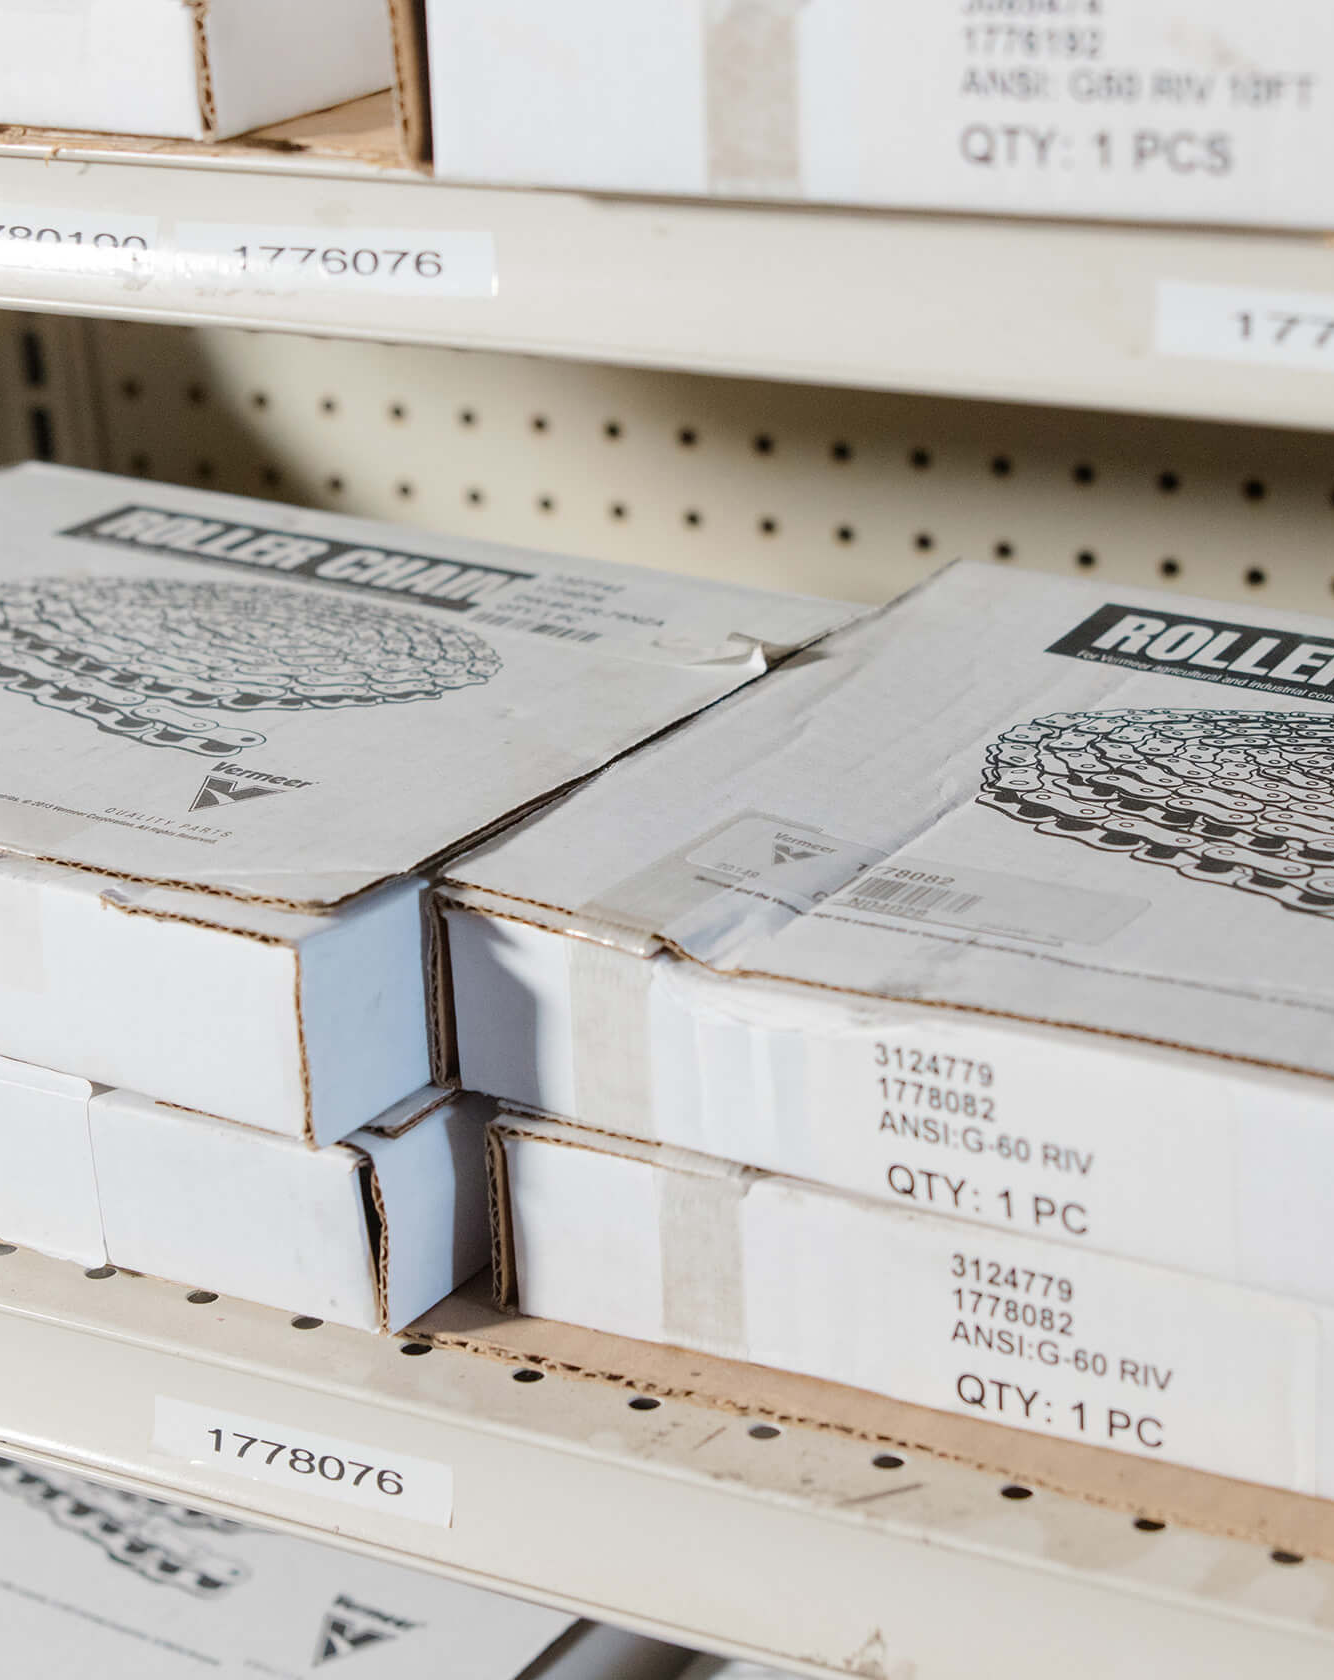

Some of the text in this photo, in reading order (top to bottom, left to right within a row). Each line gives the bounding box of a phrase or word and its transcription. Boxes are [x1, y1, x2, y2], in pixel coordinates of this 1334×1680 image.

[959, 122, 1234, 177] QTY: 1 PCS
[232, 245, 443, 278] 1776076
[95, 508, 525, 601] ROLLER CHAIN
[1077, 649, 1101, 662] For
[1100, 653, 1153, 672] Vermeer
[1152, 661, 1222, 685] agricultural
[1221, 673, 1249, 688] and
[1249, 676, 1308, 699] industrial
[210, 761, 313, 789] Vermeer
[104, 806, 233, 839] QUALITY PARTS
[772, 831, 839, 854] Vermeer
[874, 1042, 994, 1087] 3124779
[877, 1076, 996, 1122] 1778082
[879, 1110, 1094, 1175] ANSI:G-60 RIV
[887, 1164, 1089, 1236] QTY: 1 PC
[951, 1253, 1073, 1303] 3124779
[952, 1287, 1075, 1337] 1778082
[951, 1319, 1173, 1392] ANSI:G-60 RIV
[956, 1373, 1164, 1449] QTY: 1 PC
[207, 1428, 404, 1496] 1778076
